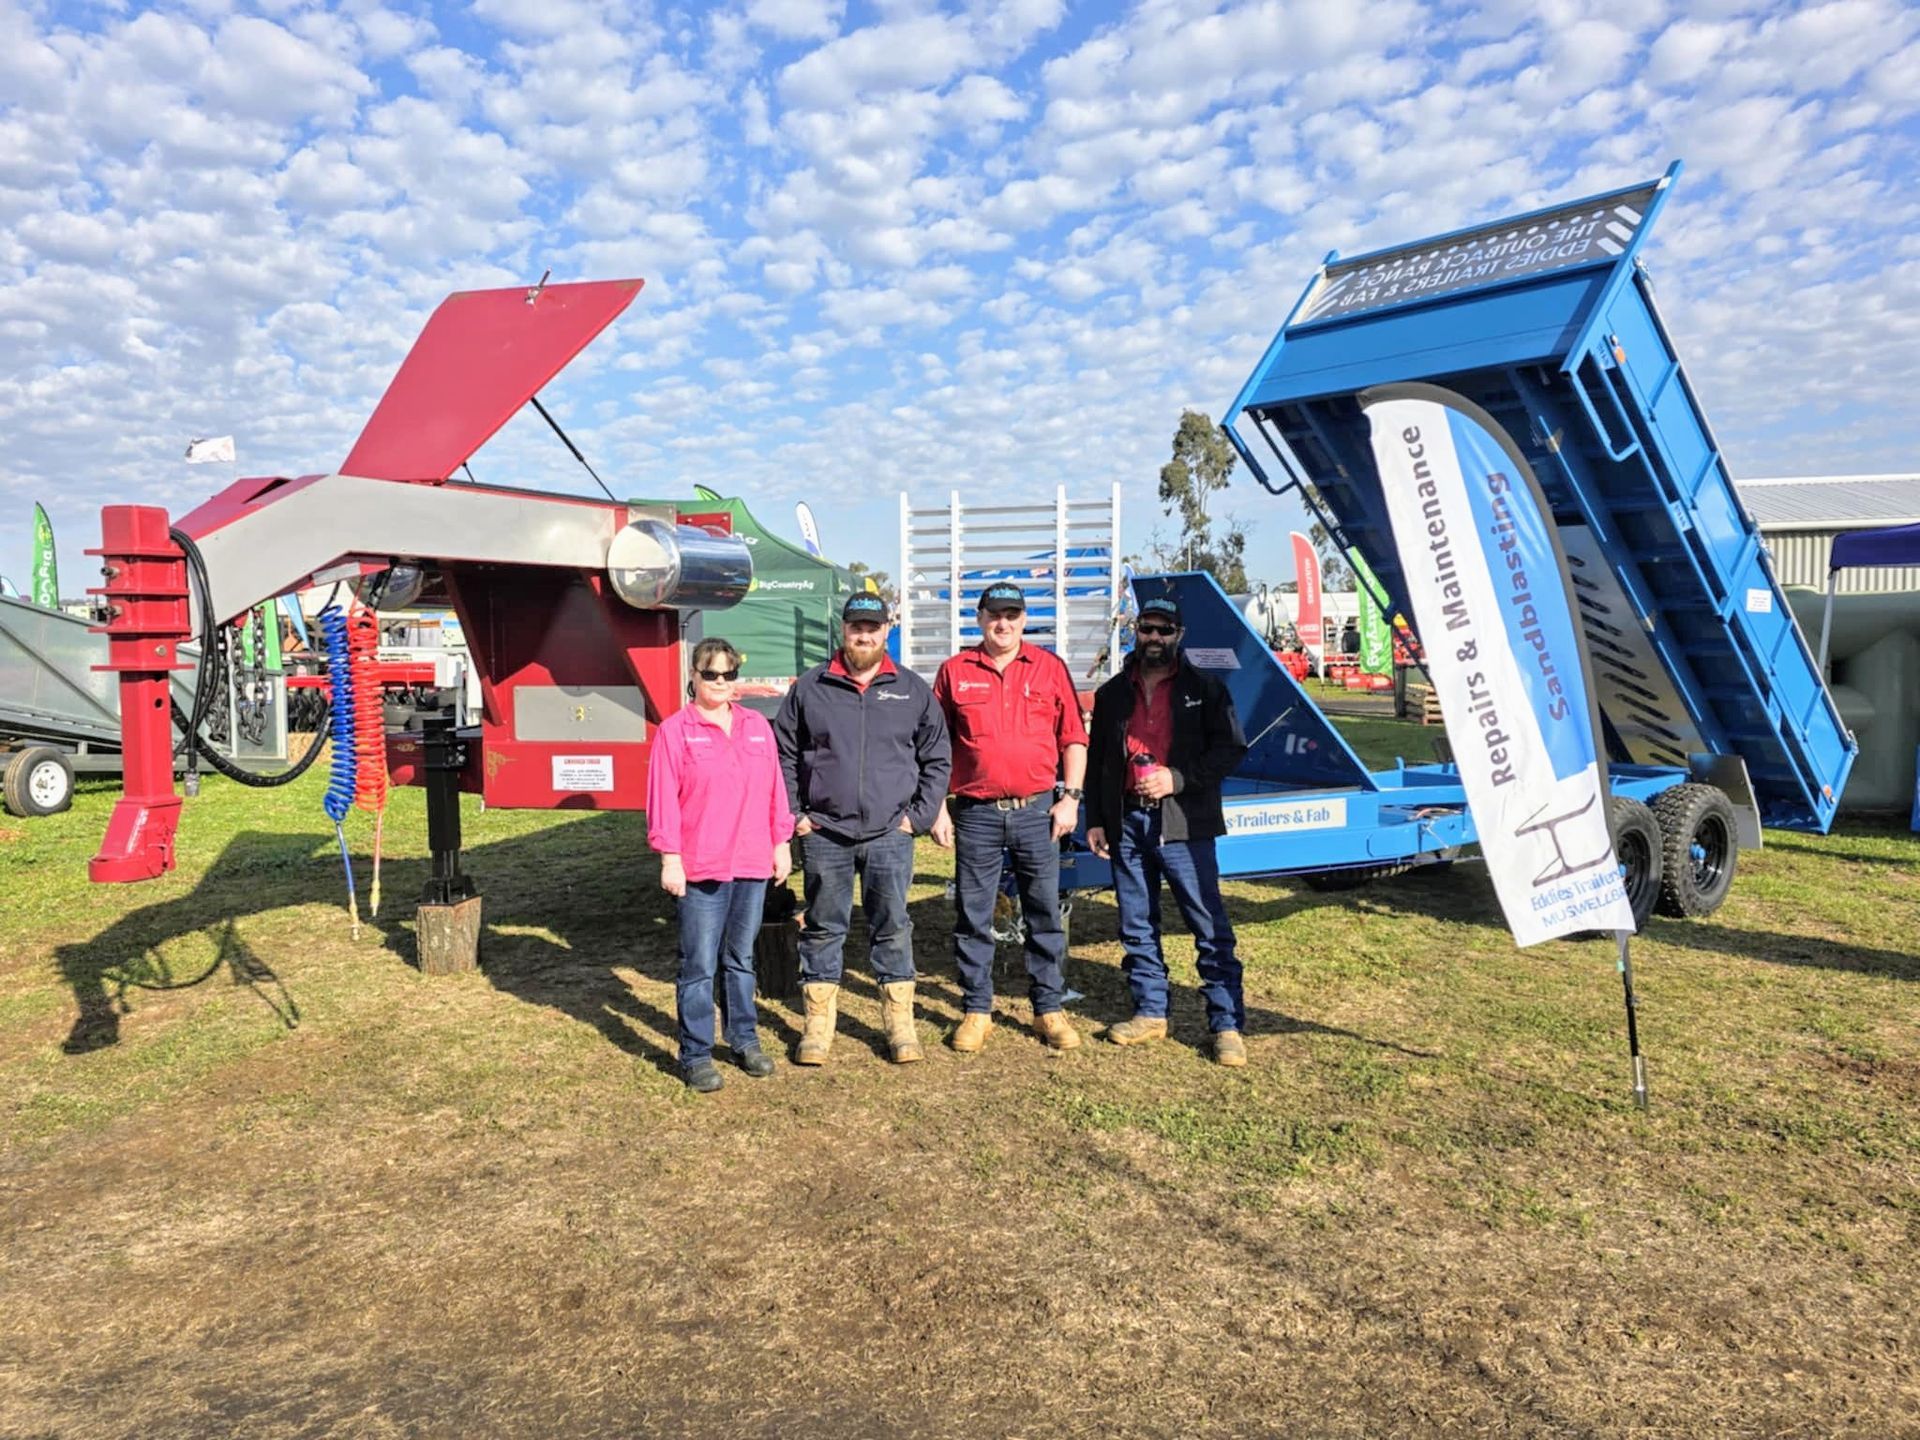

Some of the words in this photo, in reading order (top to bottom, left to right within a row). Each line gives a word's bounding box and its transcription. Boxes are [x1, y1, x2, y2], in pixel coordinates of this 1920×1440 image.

[1402, 425, 1471, 632] Maintenance
[1487, 472, 1571, 721] Sandblasting
[1456, 638, 1478, 663] &
[1466, 671, 1516, 787] Repairs
[1235, 811, 1292, 828] Trailers
[1292, 810, 1304, 823] &
[1306, 807, 1330, 822] Fab
[1530, 886, 1575, 911] Eddies
[1573, 868, 1620, 895] Trailer
